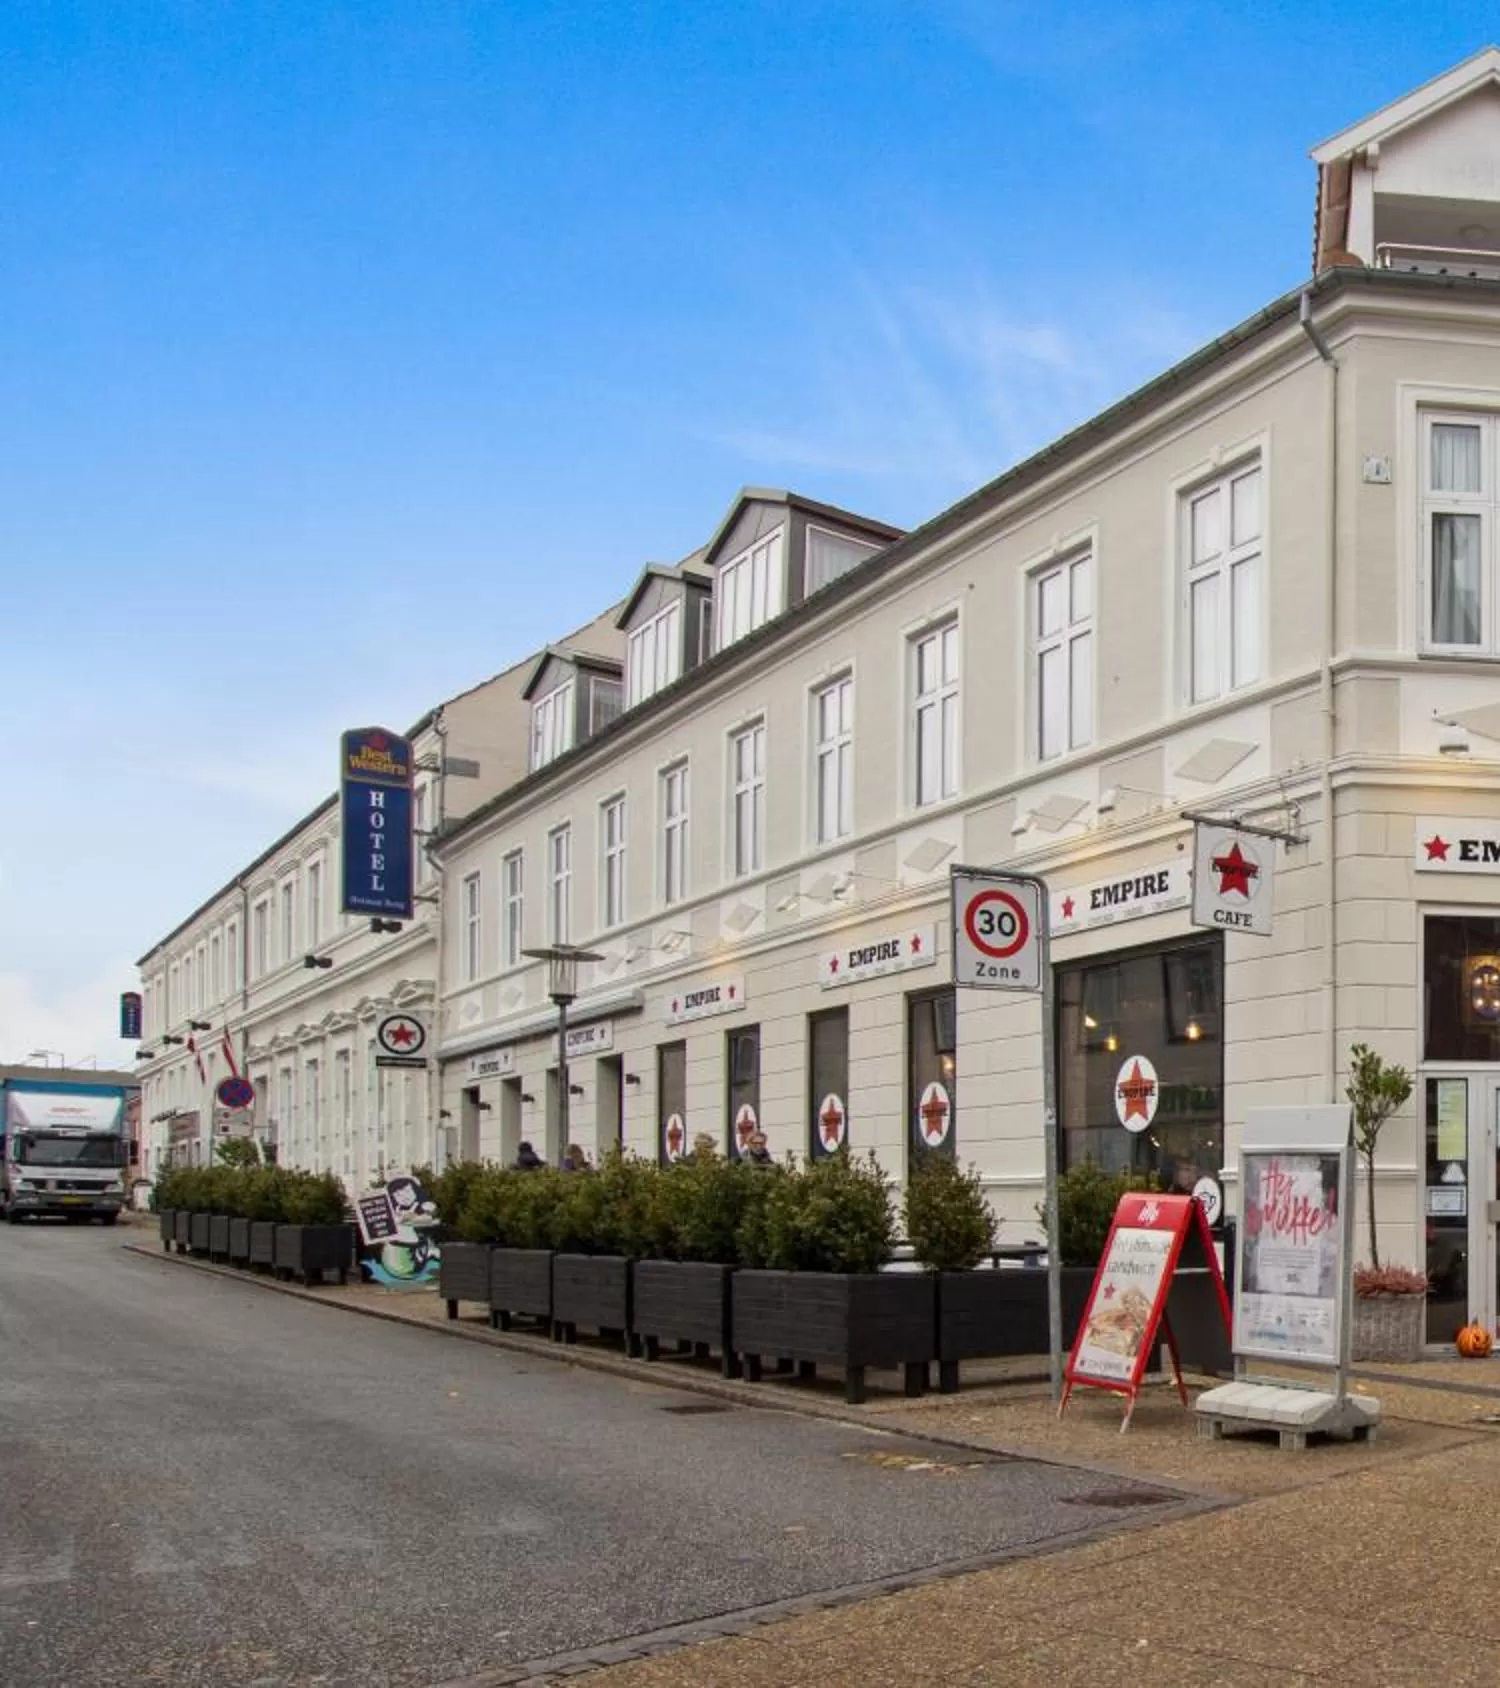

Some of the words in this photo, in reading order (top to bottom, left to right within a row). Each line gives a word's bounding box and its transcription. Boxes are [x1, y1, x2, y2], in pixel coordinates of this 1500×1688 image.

[349, 753, 407, 777] Western
[369, 790, 385, 892] HOTEL
[1089, 869, 1170, 910] EMPIRE
[977, 908, 1017, 938] 30
[1212, 908, 1253, 928] CAFE
[848, 939, 901, 969] EMPIRE
[975, 961, 1021, 980] Zone
[685, 986, 721, 1009] EMPIRE
